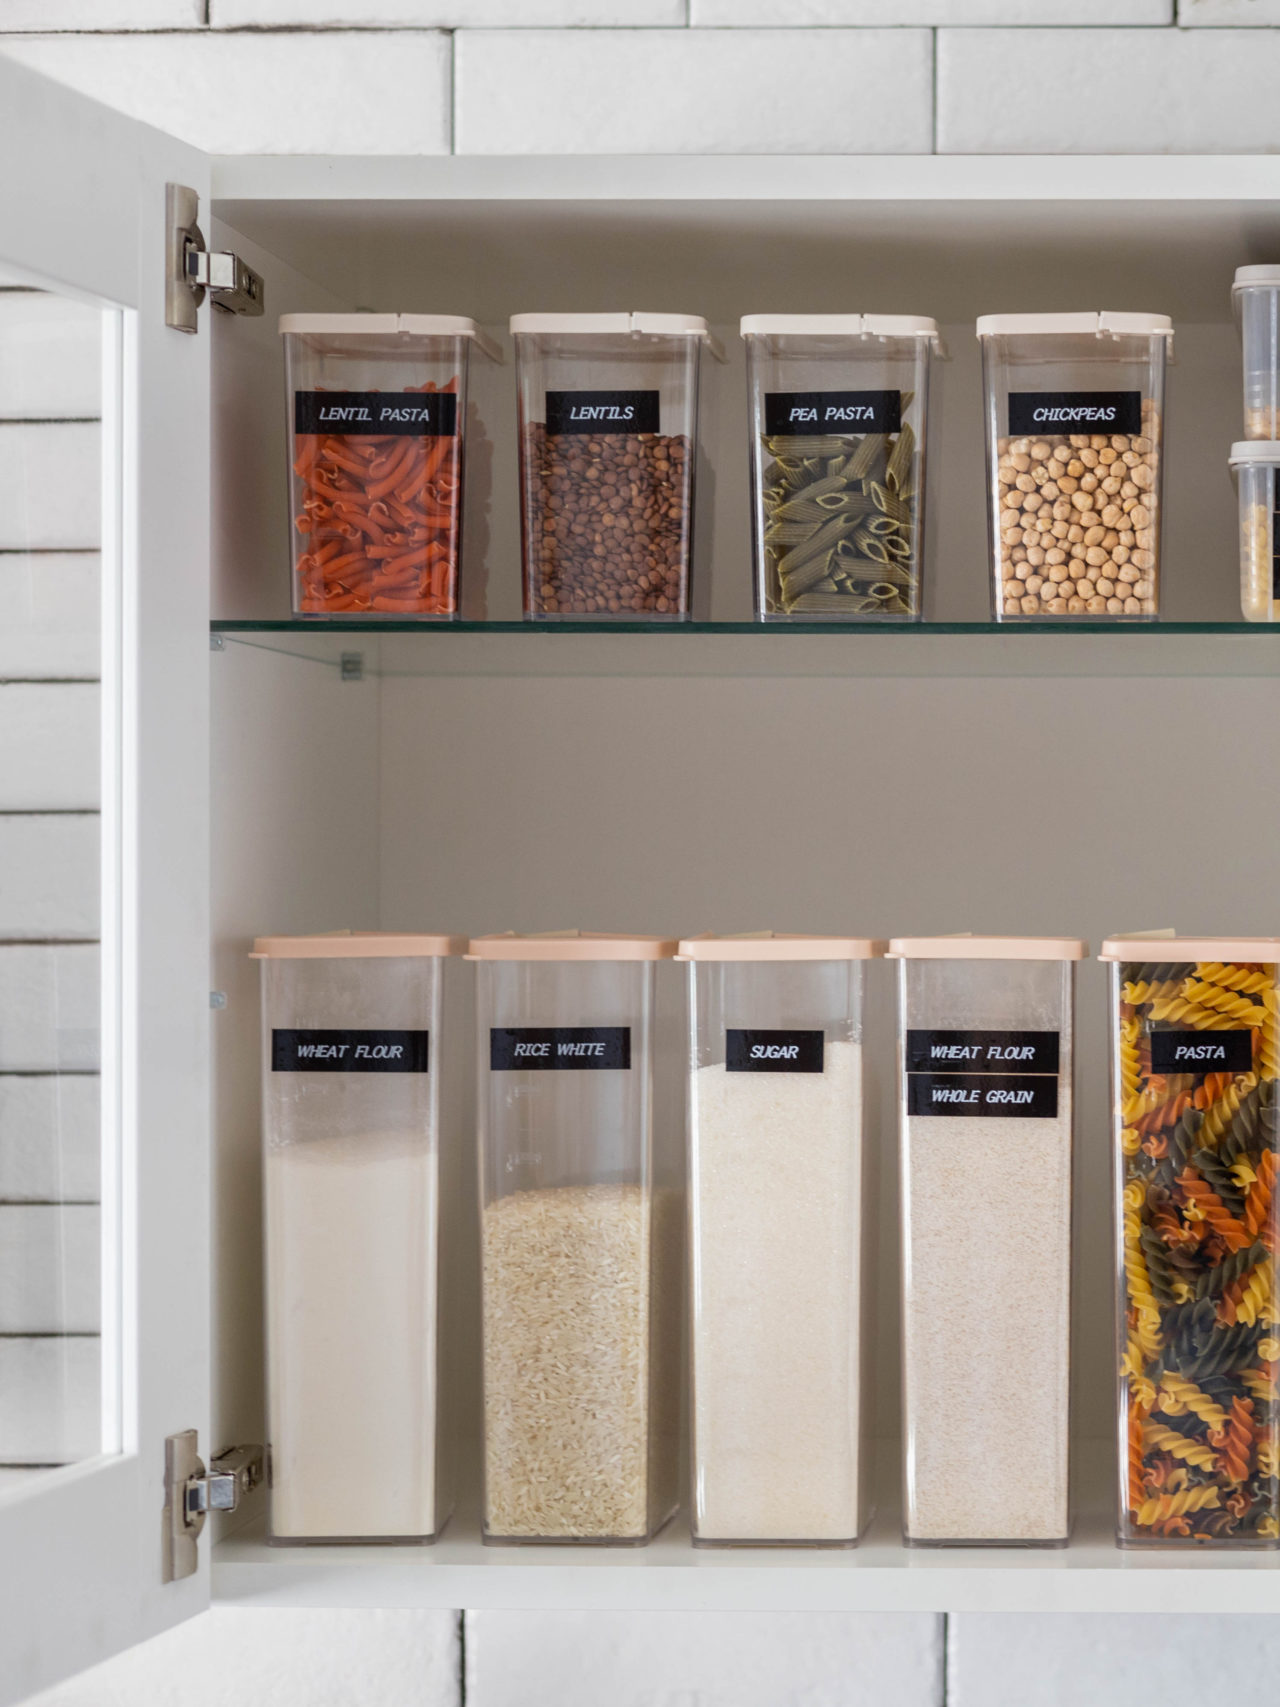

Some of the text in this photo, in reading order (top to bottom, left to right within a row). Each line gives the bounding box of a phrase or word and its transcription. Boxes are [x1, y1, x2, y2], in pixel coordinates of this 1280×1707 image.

[319, 407, 429, 422] LENTIL PASTA
[570, 405, 635, 420] LENTILS
[789, 406, 875, 422] PEA PASTA
[1032, 406, 1116, 422] CHICKPEAS
[298, 1045, 403, 1059] WHEAT FLOUR
[514, 1042, 606, 1057] RICE WHITE
[749, 1044, 800, 1059] SUGAR
[930, 1045, 1036, 1060] WHEAT FLOUR
[1174, 1045, 1225, 1060] PASTA
[932, 1089, 1034, 1104] WHOLE GRAIN
